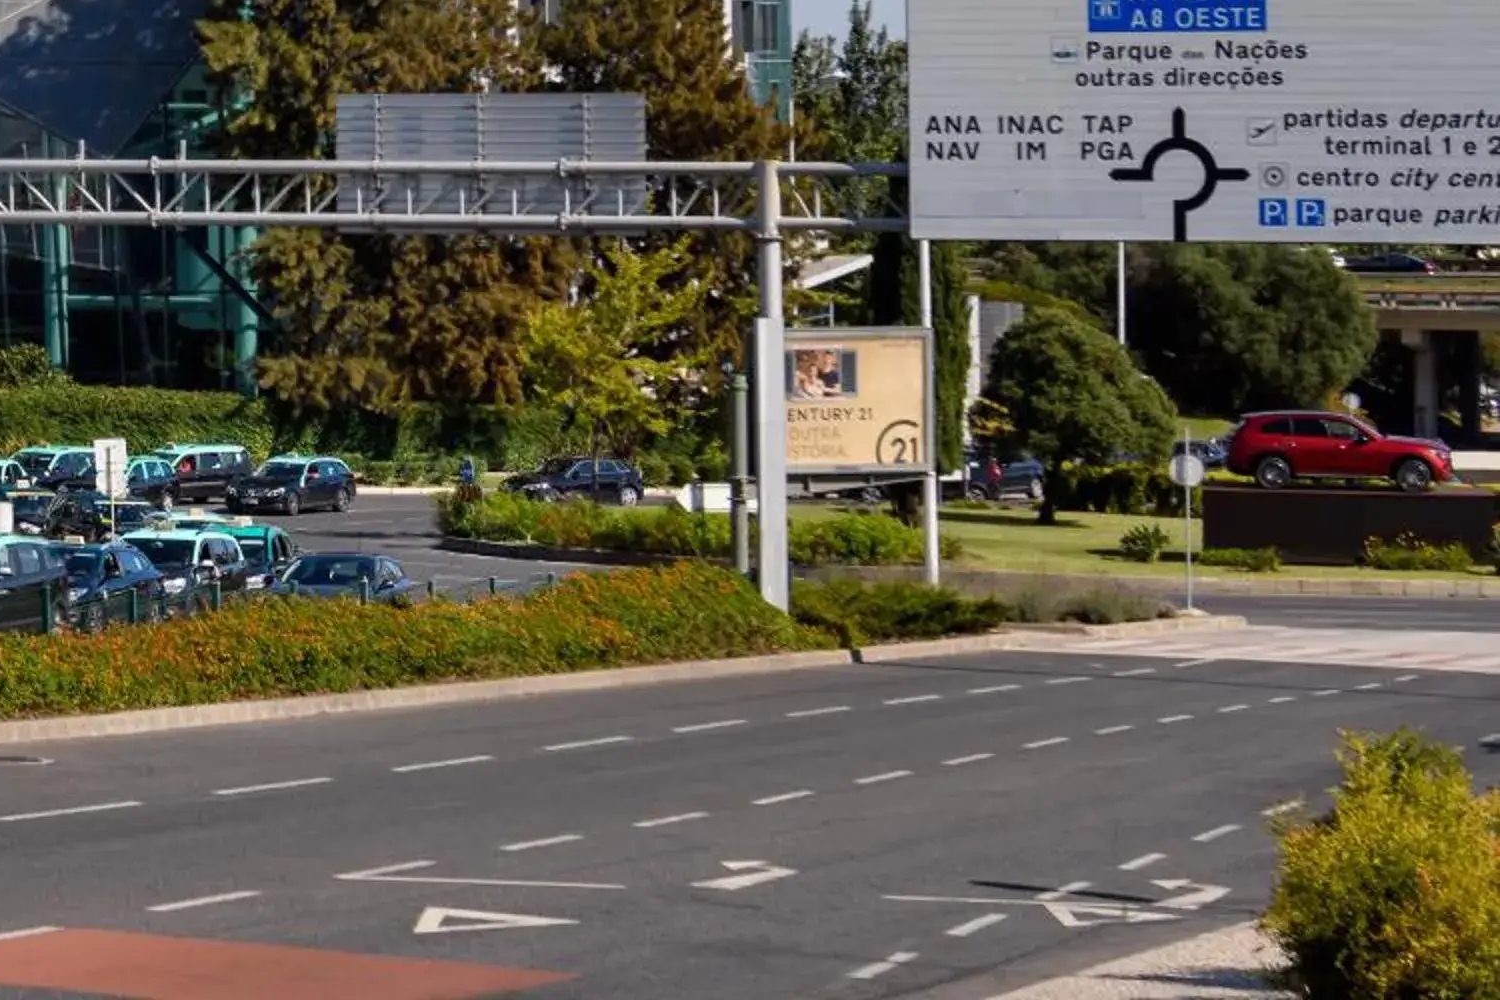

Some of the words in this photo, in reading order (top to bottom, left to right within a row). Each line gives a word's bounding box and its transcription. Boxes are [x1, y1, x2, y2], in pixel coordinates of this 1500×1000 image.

[1131, 9, 1163, 29] A8
[1175, 8, 1262, 28] OESTE
[1086, 41, 1173, 63] Parque
[1214, 40, 1308, 63] Nações
[1075, 69, 1154, 88] outras
[1163, 67, 1284, 89] direcções
[925, 115, 981, 134] ANA
[997, 115, 1064, 134] INAC
[1082, 115, 1133, 134] TAP
[1283, 108, 1388, 131] partidas
[926, 142, 980, 161] NAV
[1016, 142, 1047, 161] IM
[1080, 142, 1134, 161] PGA
[1324, 136, 1432, 156] terminal
[1442, 136, 1452, 155] 1
[1463, 141, 1477, 156] e
[1487, 136, 1500, 155] 2
[1297, 168, 1379, 187] centro
[1390, 167, 1438, 190] city
[1333, 206, 1423, 223] parque
[787, 407, 853, 422] ENTURY
